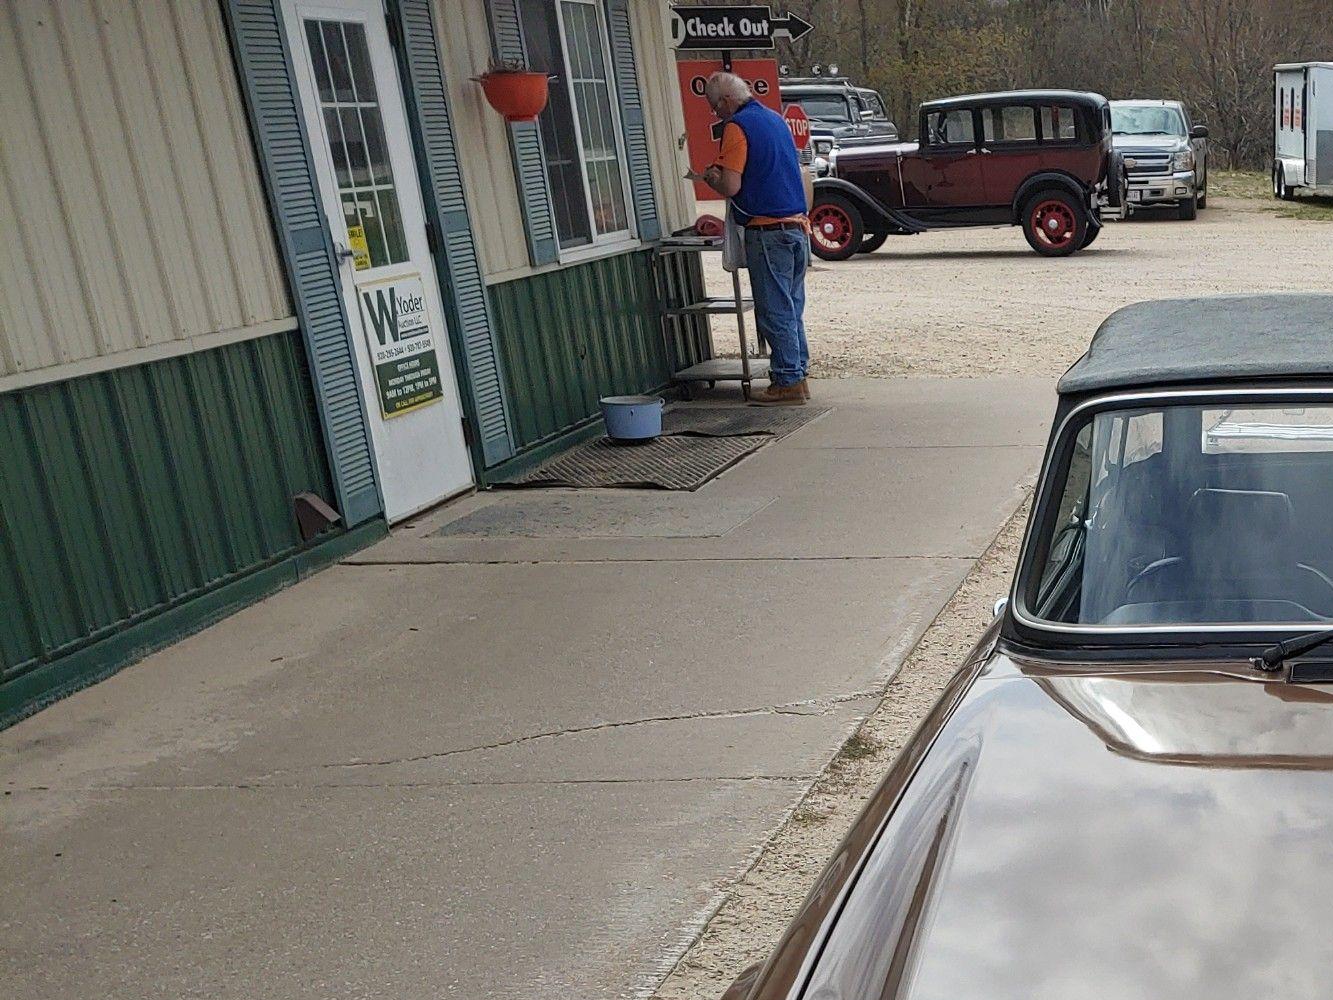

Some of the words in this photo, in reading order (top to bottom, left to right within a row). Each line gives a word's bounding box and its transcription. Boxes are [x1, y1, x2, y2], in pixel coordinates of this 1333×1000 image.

[686, 17, 735, 37] Check
[739, 17, 769, 37] Out
[396, 293, 424, 315] Yoder
